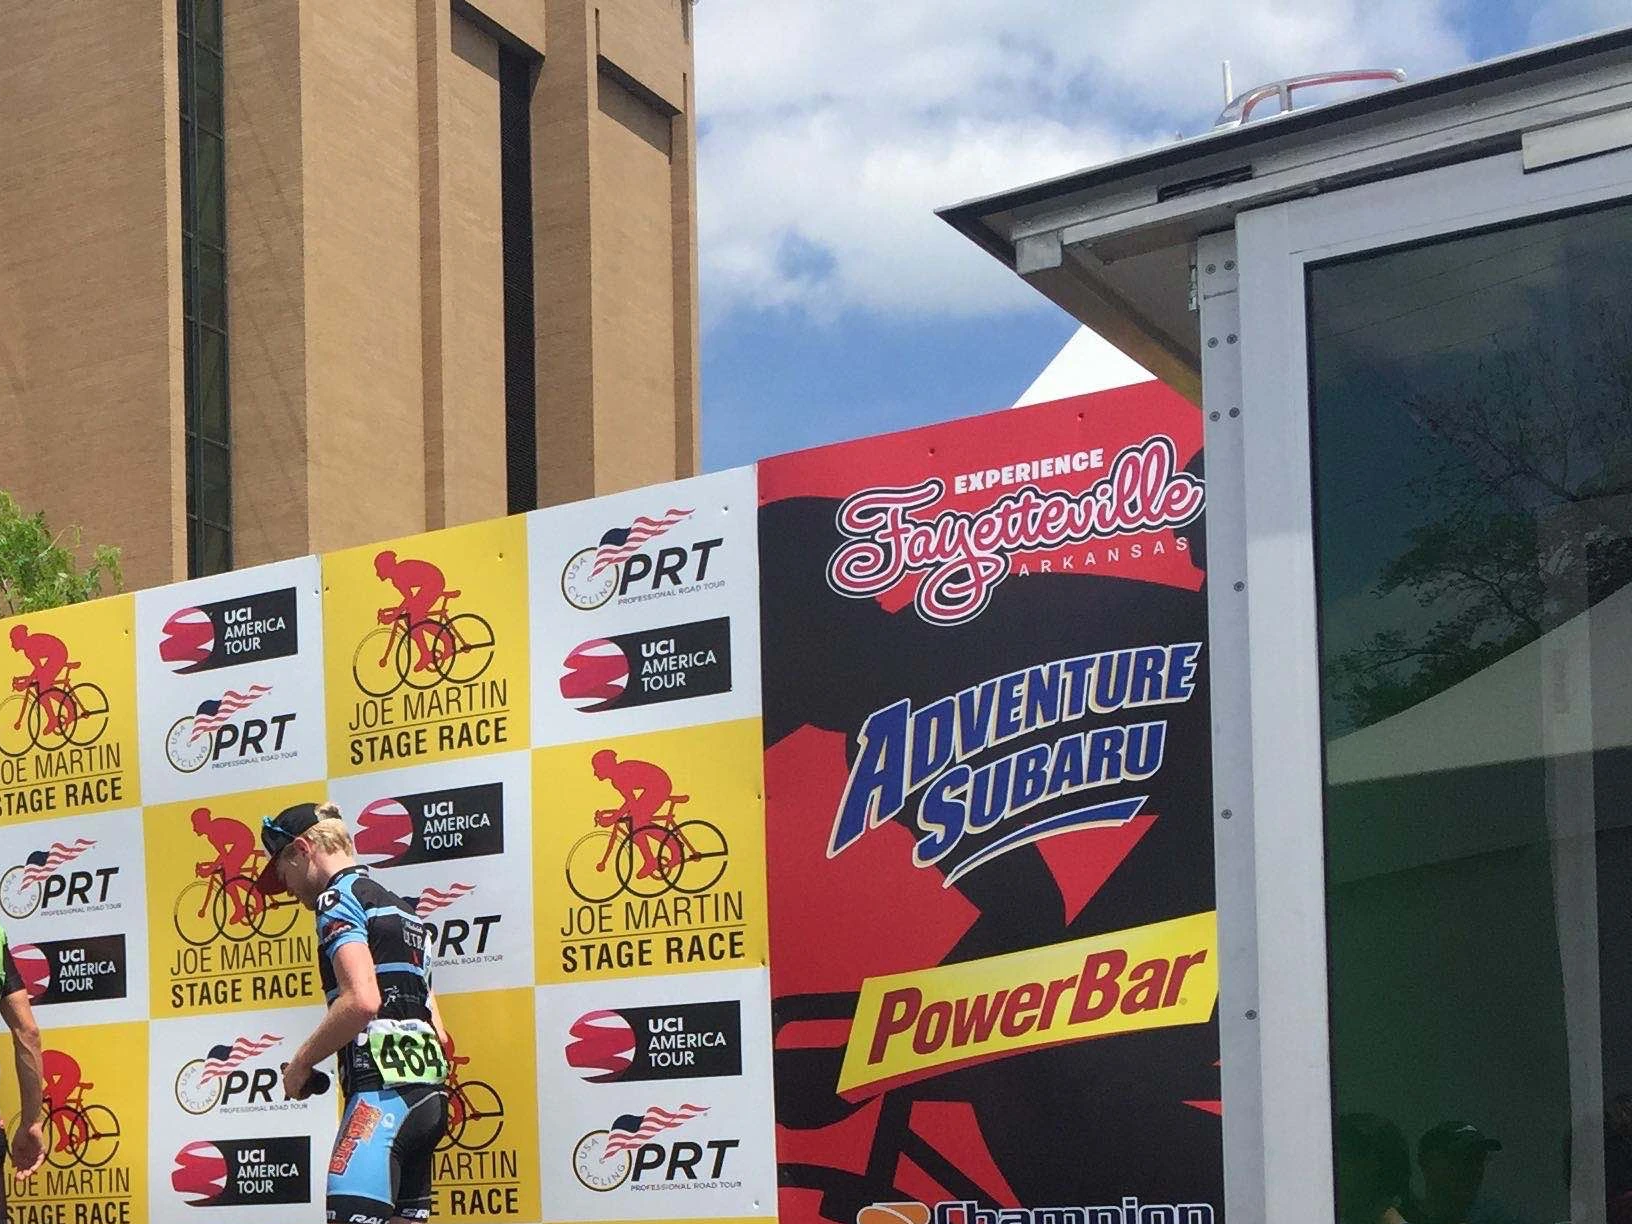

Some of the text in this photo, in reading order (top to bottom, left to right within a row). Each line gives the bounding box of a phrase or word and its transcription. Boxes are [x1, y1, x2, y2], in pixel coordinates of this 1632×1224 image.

[955, 448, 1103, 495] EXPERIENCE
[826, 434, 1206, 626] Fayetteville
[618, 538, 724, 596] PRT
[1020, 536, 1188, 577] ARKANSAS
[618, 590, 676, 606] PROFESSIONAL
[224, 607, 252, 624] UCI
[224, 616, 286, 640] AMERICA
[224, 637, 261, 655] TOUR
[641, 639, 675, 658] UCI
[641, 650, 717, 676] AMERICA
[641, 674, 686, 692] TOUR
[349, 679, 507, 731] JOE MARTIN
[212, 713, 297, 761] PRT
[350, 716, 507, 765] STAGE RACE
[827, 642, 1202, 859] ADVENTURE
[35, 742, 121, 779] MARTIN
[65, 777, 123, 807] RACE
[912, 721, 1165, 867] SUBARU
[423, 801, 454, 818] UCI
[423, 813, 491, 835] AMERICA
[423, 833, 463, 851] TOUR
[41, 867, 119, 909] PRT
[561, 891, 743, 937] JOE MARTIN
[59, 949, 85, 964] UCI
[170, 936, 312, 976] JOE MARTIN
[562, 931, 745, 973] STAGE RACE
[59, 961, 116, 978] AMERICA
[59, 978, 94, 993] TOUR
[171, 972, 313, 1009] STAGE RACE
[868, 949, 1207, 1065] PowerBar
[648, 1016, 683, 1034] UCI
[648, 1031, 727, 1050] AMERICA
[380, 1034, 443, 1078] 464
[648, 1050, 695, 1067] TOUR
[221, 1068, 290, 1106] PR
[237, 1149, 266, 1164] UCI
[579, 1138, 599, 1159] USA
[631, 1139, 740, 1182] PRT
[46, 1167, 130, 1196] MARTIN
[237, 1163, 299, 1179] AMERICA
[579, 1163, 626, 1186] CYCLING
[237, 1179, 274, 1194] TOUR
[630, 1181, 743, 1192] PROFESSIONAL ROAD TOUR
[451, 1188, 519, 1216] RACE
